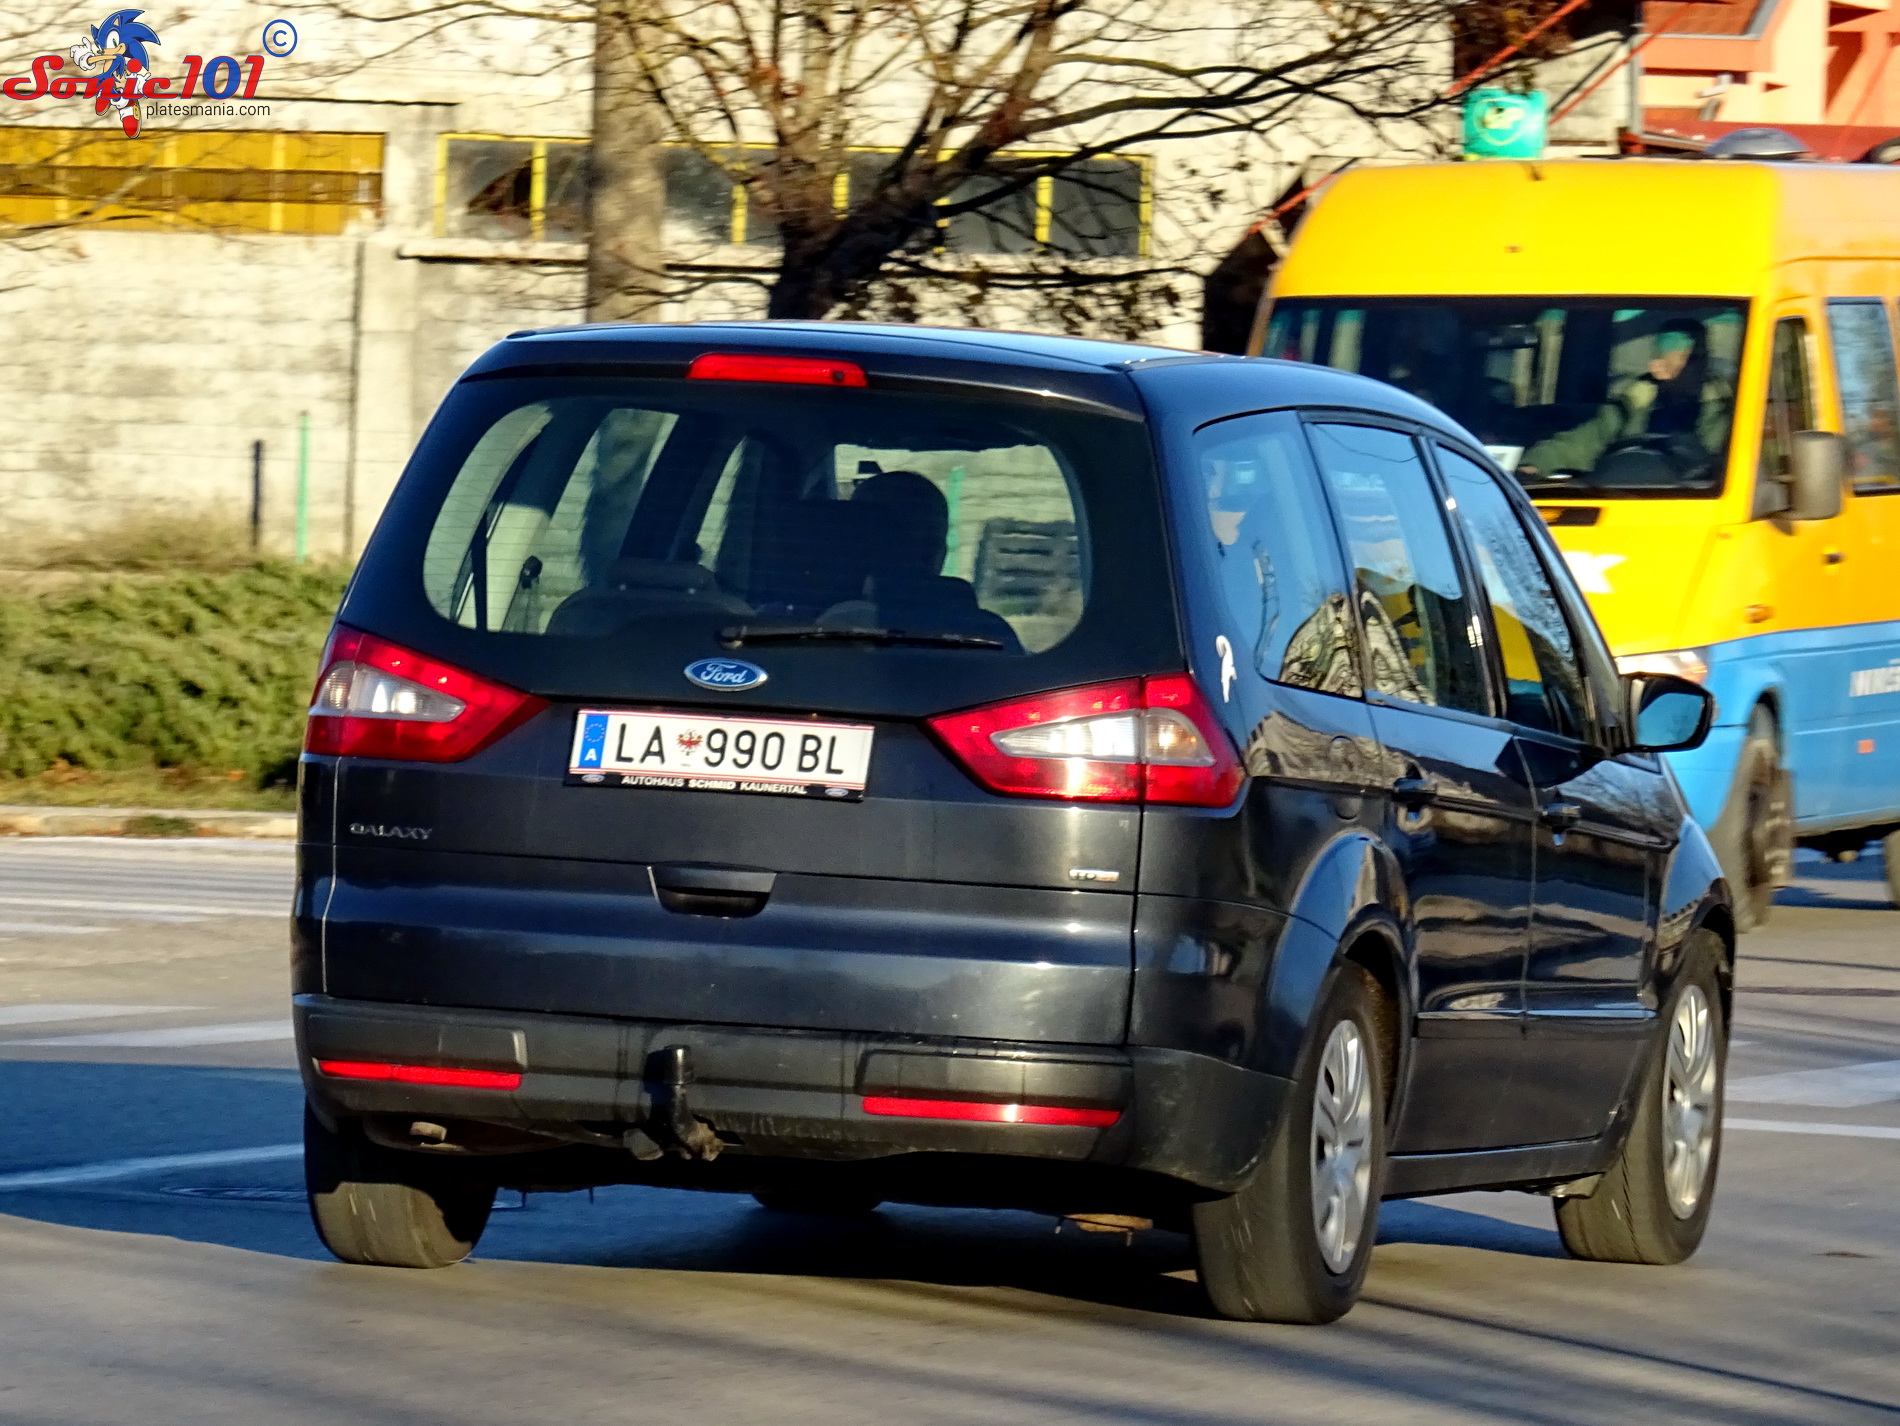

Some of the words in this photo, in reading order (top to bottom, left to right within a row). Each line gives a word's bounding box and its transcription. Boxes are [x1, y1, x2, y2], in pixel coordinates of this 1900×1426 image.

[700, 663, 748, 684] Ford
[584, 748, 598, 762] A
[614, 722, 666, 765] LA
[704, 728, 786, 771] 990
[797, 733, 844, 776] BL
[621, 775, 684, 788] AUTOHAUS
[688, 778, 736, 791] SCHMID
[740, 781, 808, 795] KAUNERTAL
